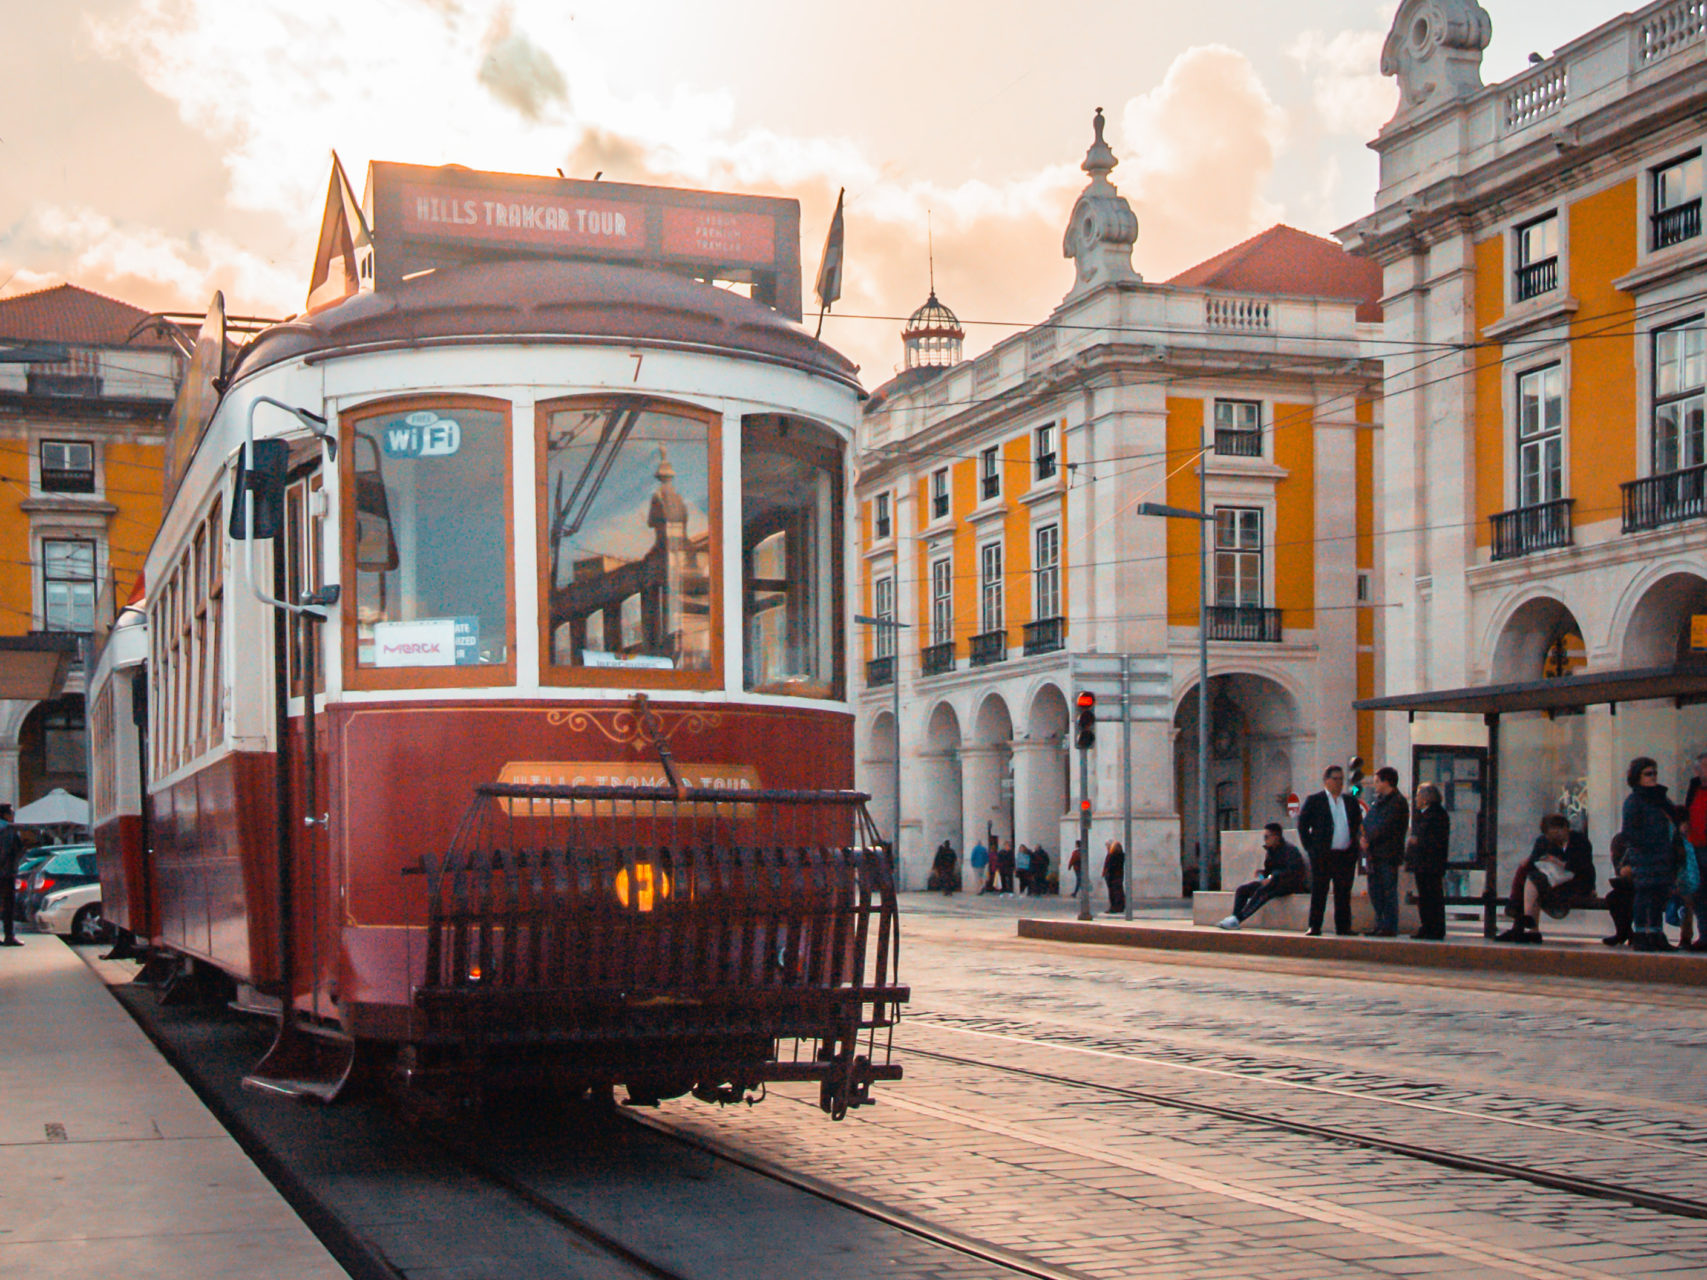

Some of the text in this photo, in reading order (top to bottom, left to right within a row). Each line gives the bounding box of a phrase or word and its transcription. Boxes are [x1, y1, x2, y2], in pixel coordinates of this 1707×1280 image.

[417, 197, 627, 236] HILLS TRAMCAR TOUR
